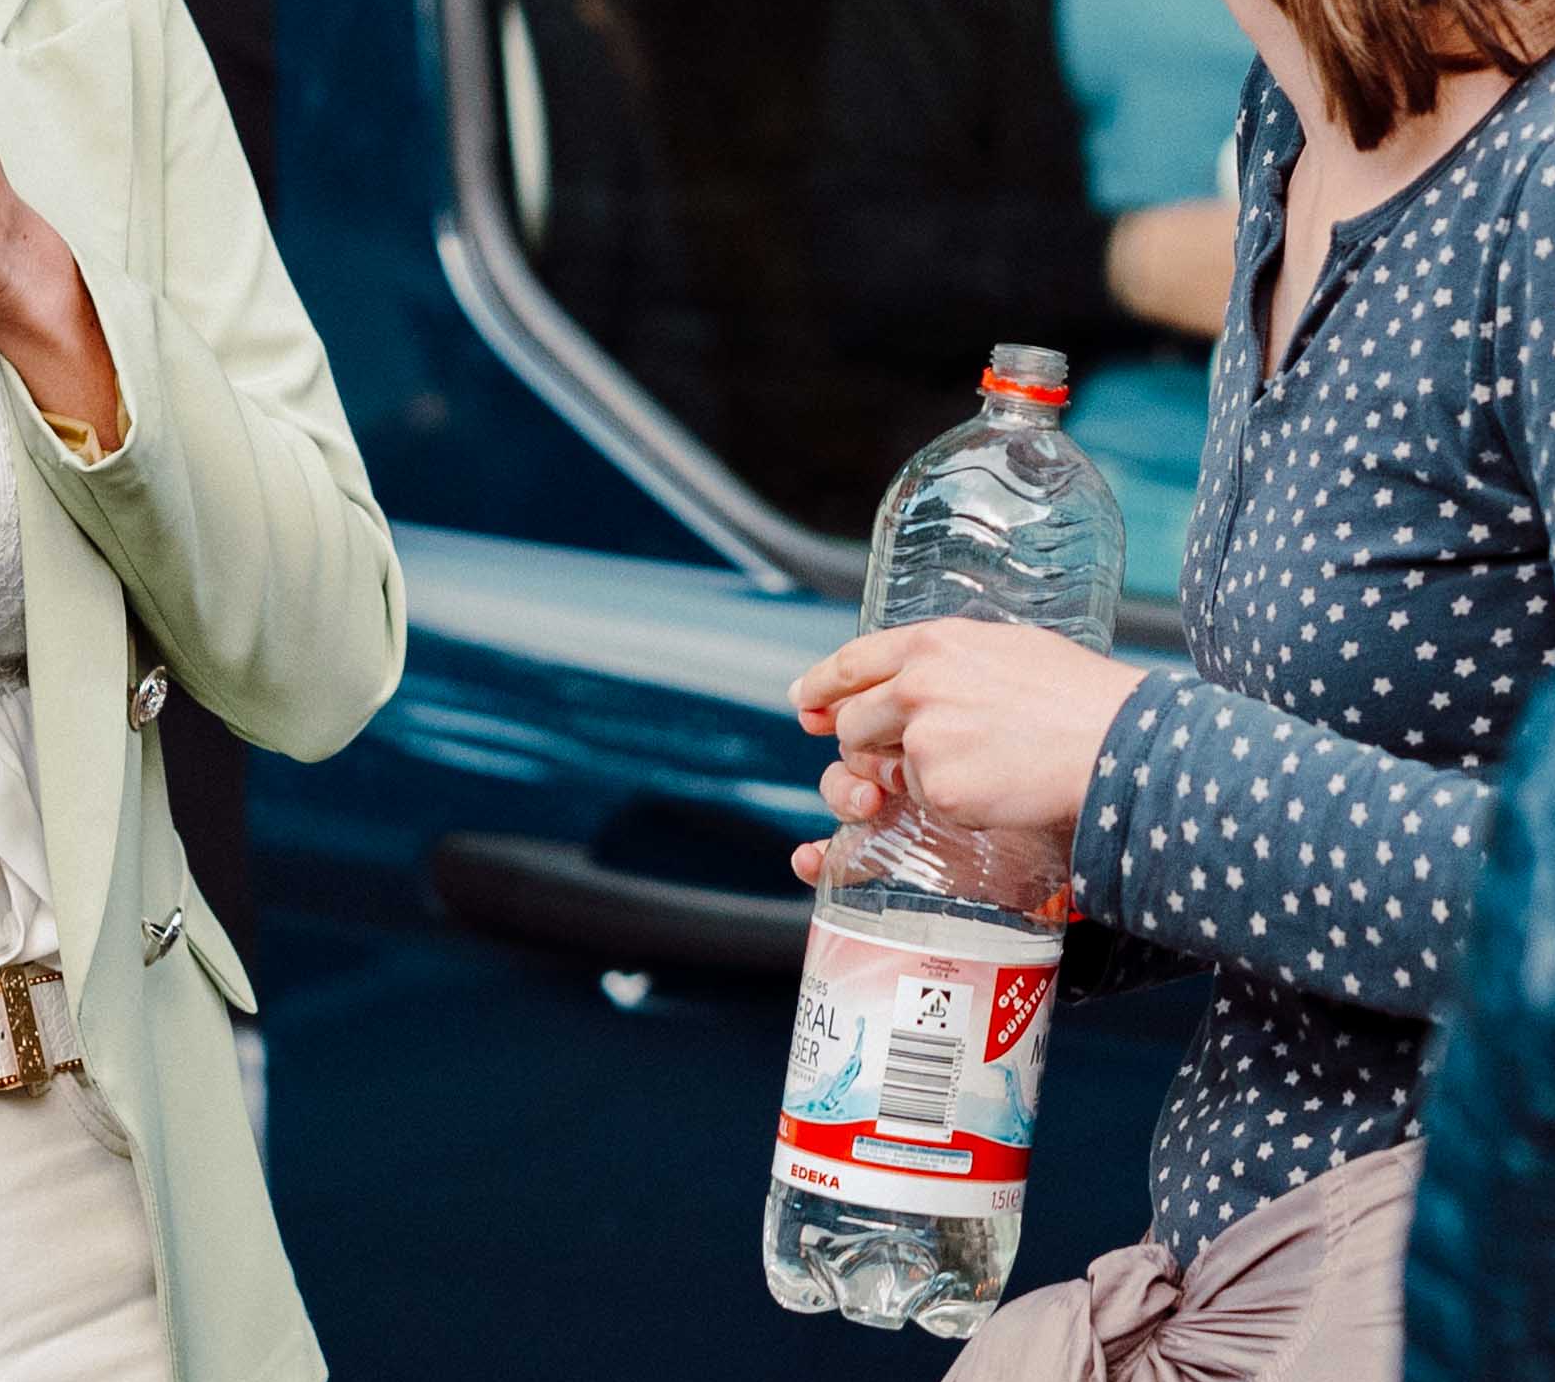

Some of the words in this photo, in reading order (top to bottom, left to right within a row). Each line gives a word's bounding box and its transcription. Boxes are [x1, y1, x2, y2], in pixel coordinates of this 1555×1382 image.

[998, 975, 1025, 1008] GUT
[1012, 996, 1025, 1011] &
[998, 977, 1047, 1044] GÜNSTIG
[790, 1163, 840, 1190] EDEKA
